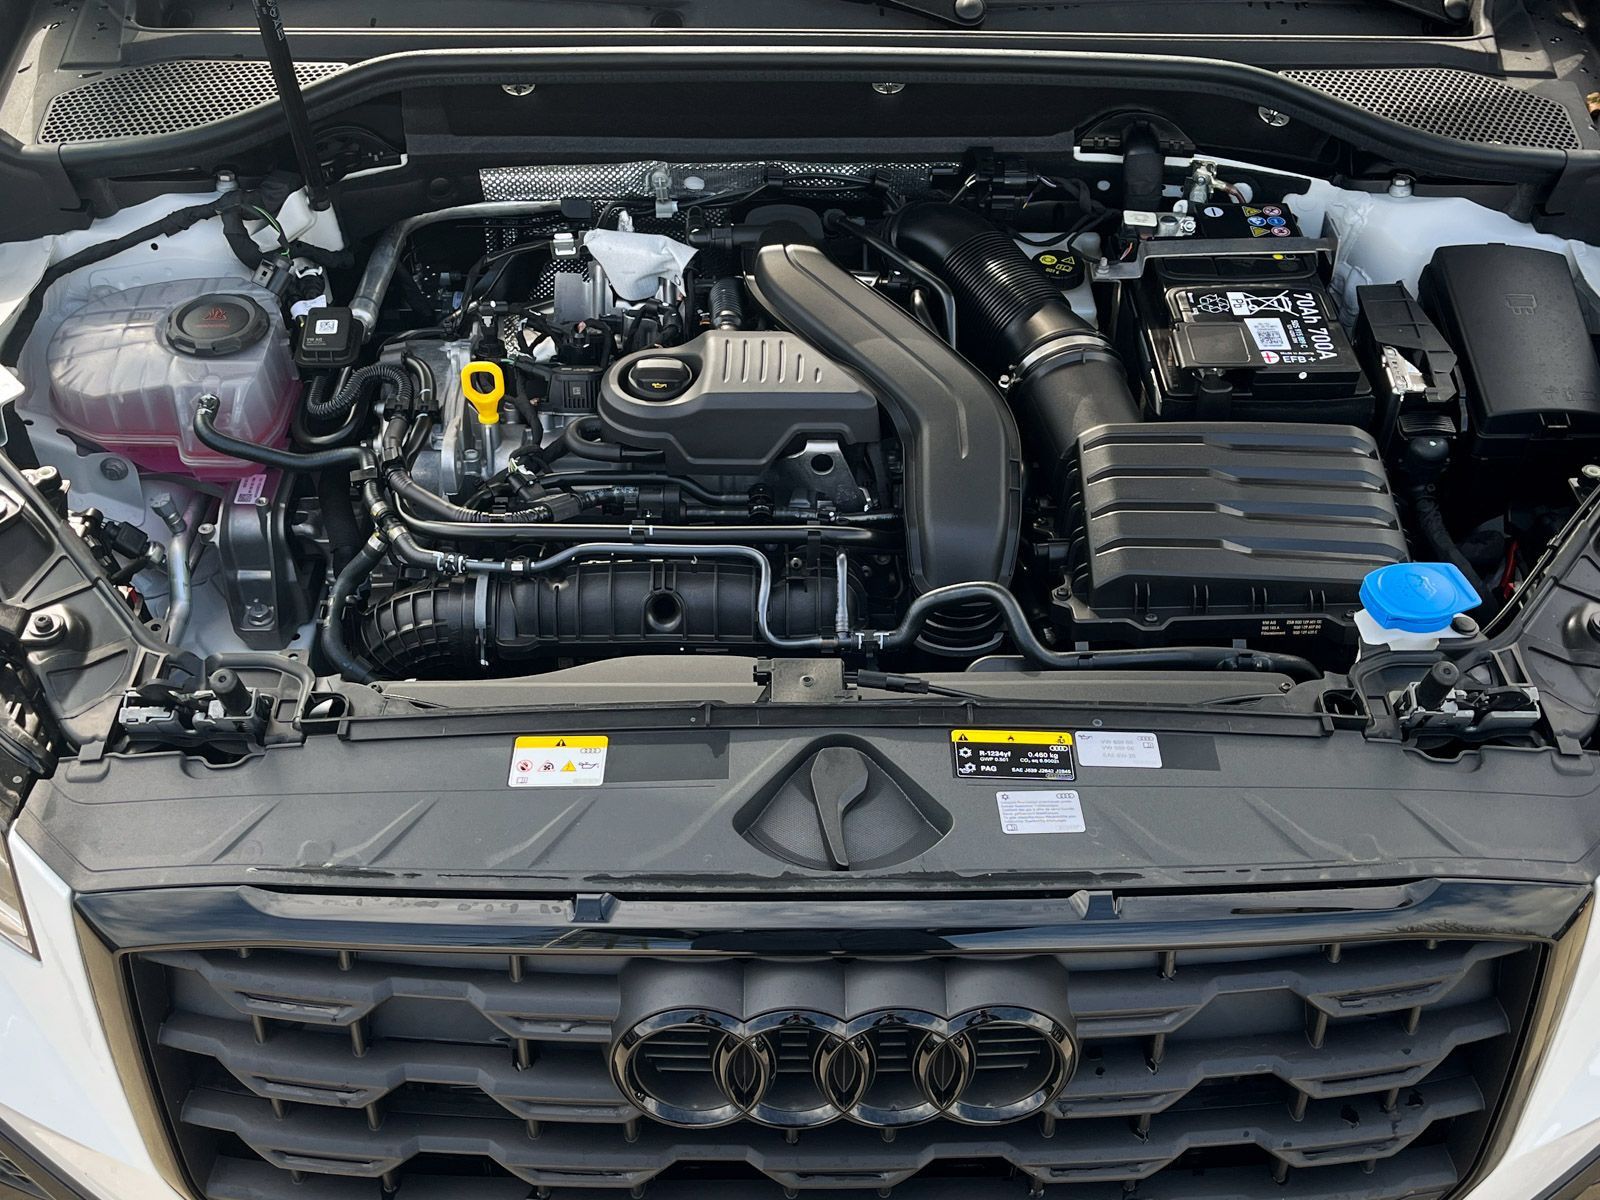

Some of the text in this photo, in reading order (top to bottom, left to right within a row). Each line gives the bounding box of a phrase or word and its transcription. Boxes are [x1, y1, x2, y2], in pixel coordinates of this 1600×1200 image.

[1232, 299, 1244, 308] Pb
[1293, 292, 1338, 360] 70Ah 700A
[1282, 355, 1307, 363] EFB
